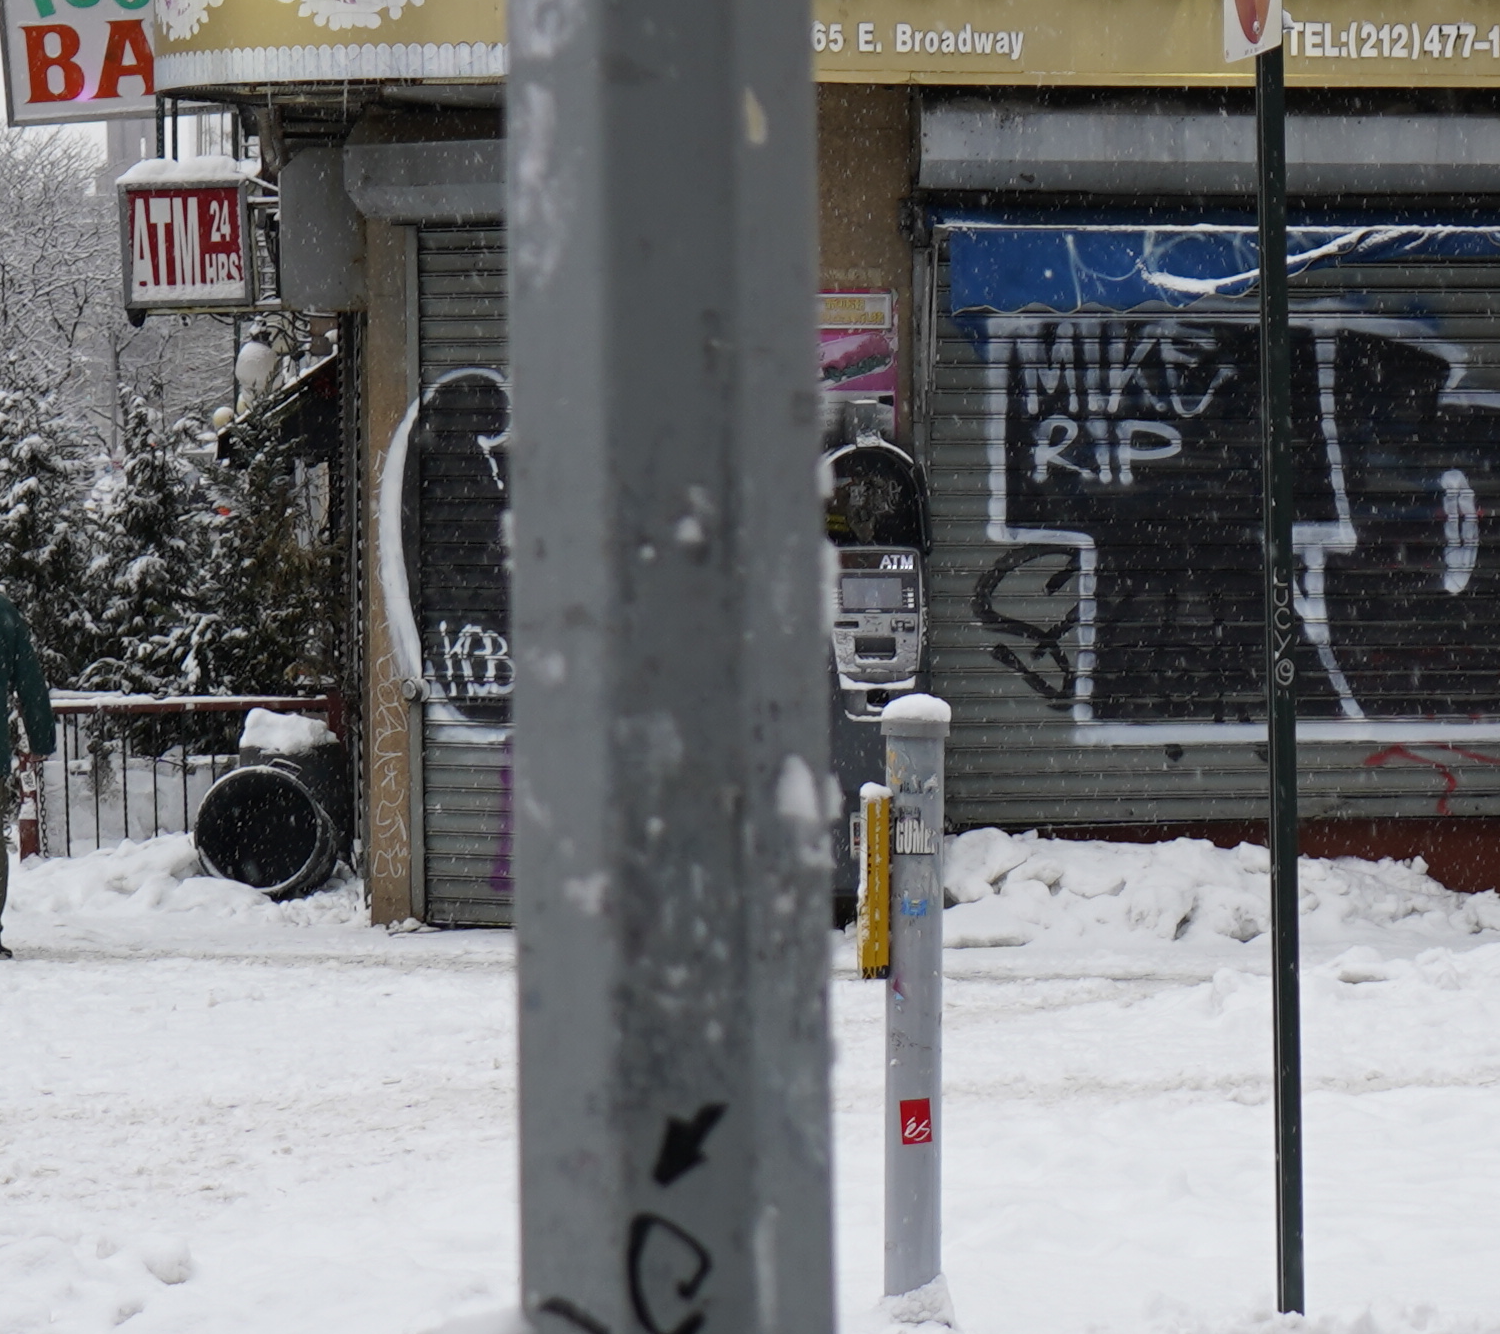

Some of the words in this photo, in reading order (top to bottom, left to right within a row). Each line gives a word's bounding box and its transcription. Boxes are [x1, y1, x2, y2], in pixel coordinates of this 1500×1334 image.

[858, 23, 882, 53] E.
[896, 23, 1024, 60] Broadway
[209, 200, 231, 242] 24
[132, 196, 202, 286] ATM
[205, 252, 241, 284] HRS
[1032, 414, 1183, 487] RIP
[880, 554, 914, 570] ATM
